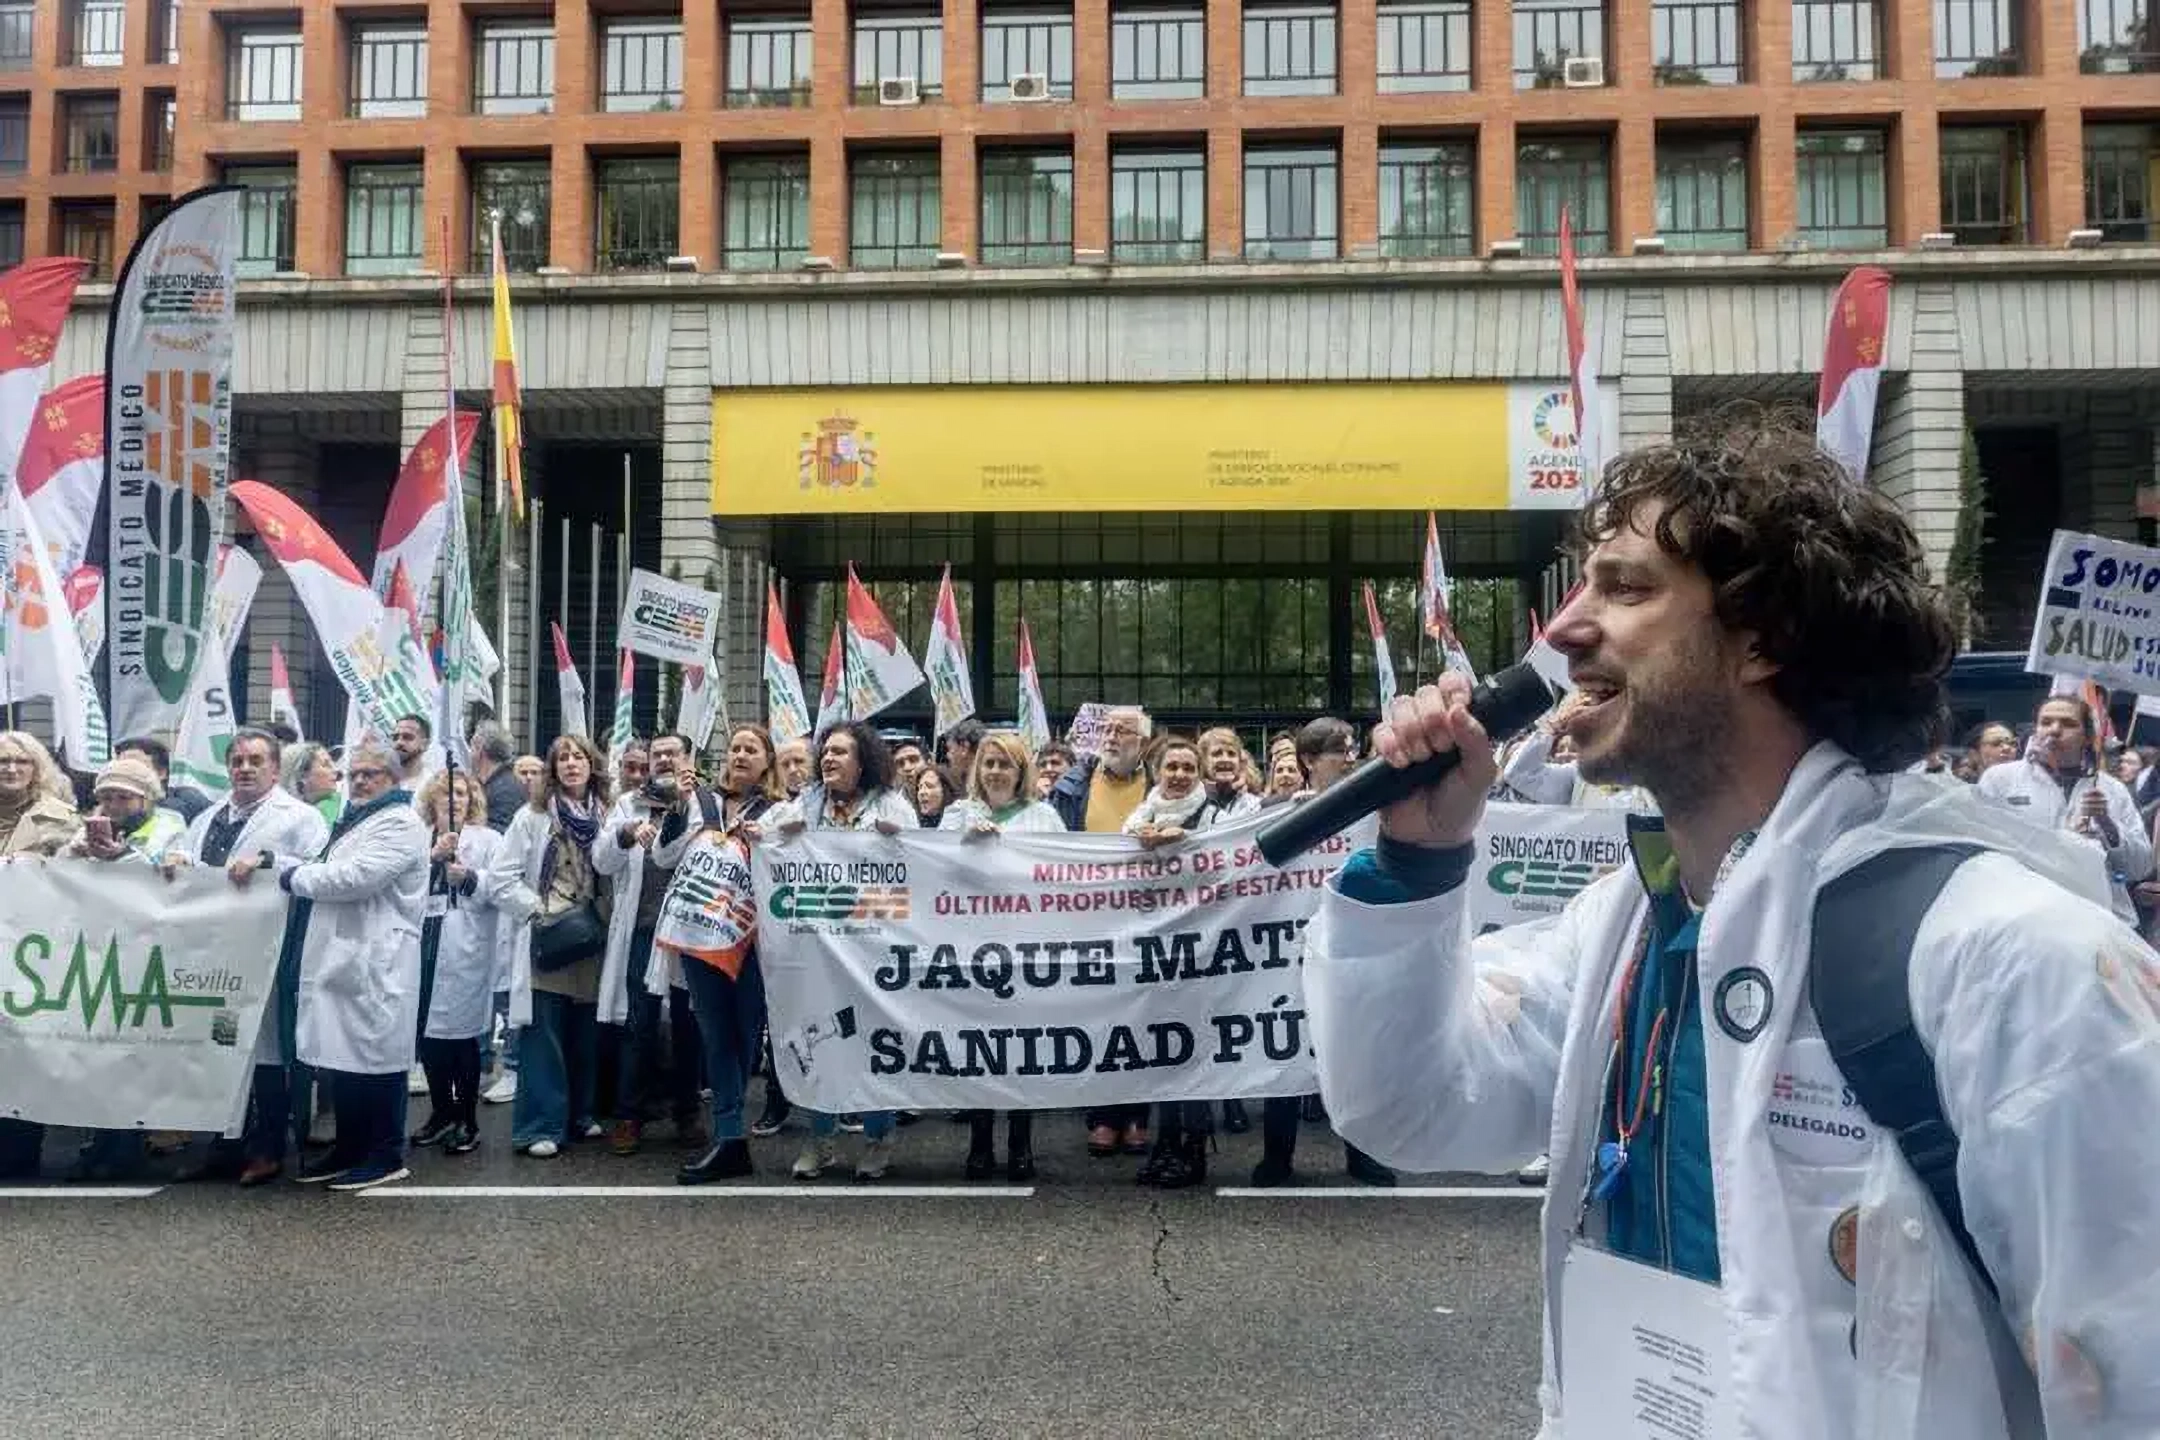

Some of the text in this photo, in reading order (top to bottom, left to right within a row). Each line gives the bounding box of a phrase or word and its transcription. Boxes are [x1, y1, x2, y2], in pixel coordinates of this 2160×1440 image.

[117, 384, 144, 675] SINDICATO MÉDICO
[2046, 616, 2130, 662] SALUD
[1033, 855, 1182, 882] MINISTERIO
[1193, 847, 1226, 872] DE
[1490, 833, 1630, 865] SINDICATO MÉDIC
[847, 858, 907, 884] MÉDICO
[935, 890, 1032, 915] ÚLTIMA
[1040, 887, 1188, 914] PROPUESTA
[1198, 884, 1229, 906] DE
[4, 928, 174, 1032] SMA
[169, 967, 243, 991] Sevilla
[874, 939, 1117, 999] JAQUE
[870, 994, 1316, 1077] SANIDAD PÚ
[1768, 1110, 1866, 1140] DELEGADO
